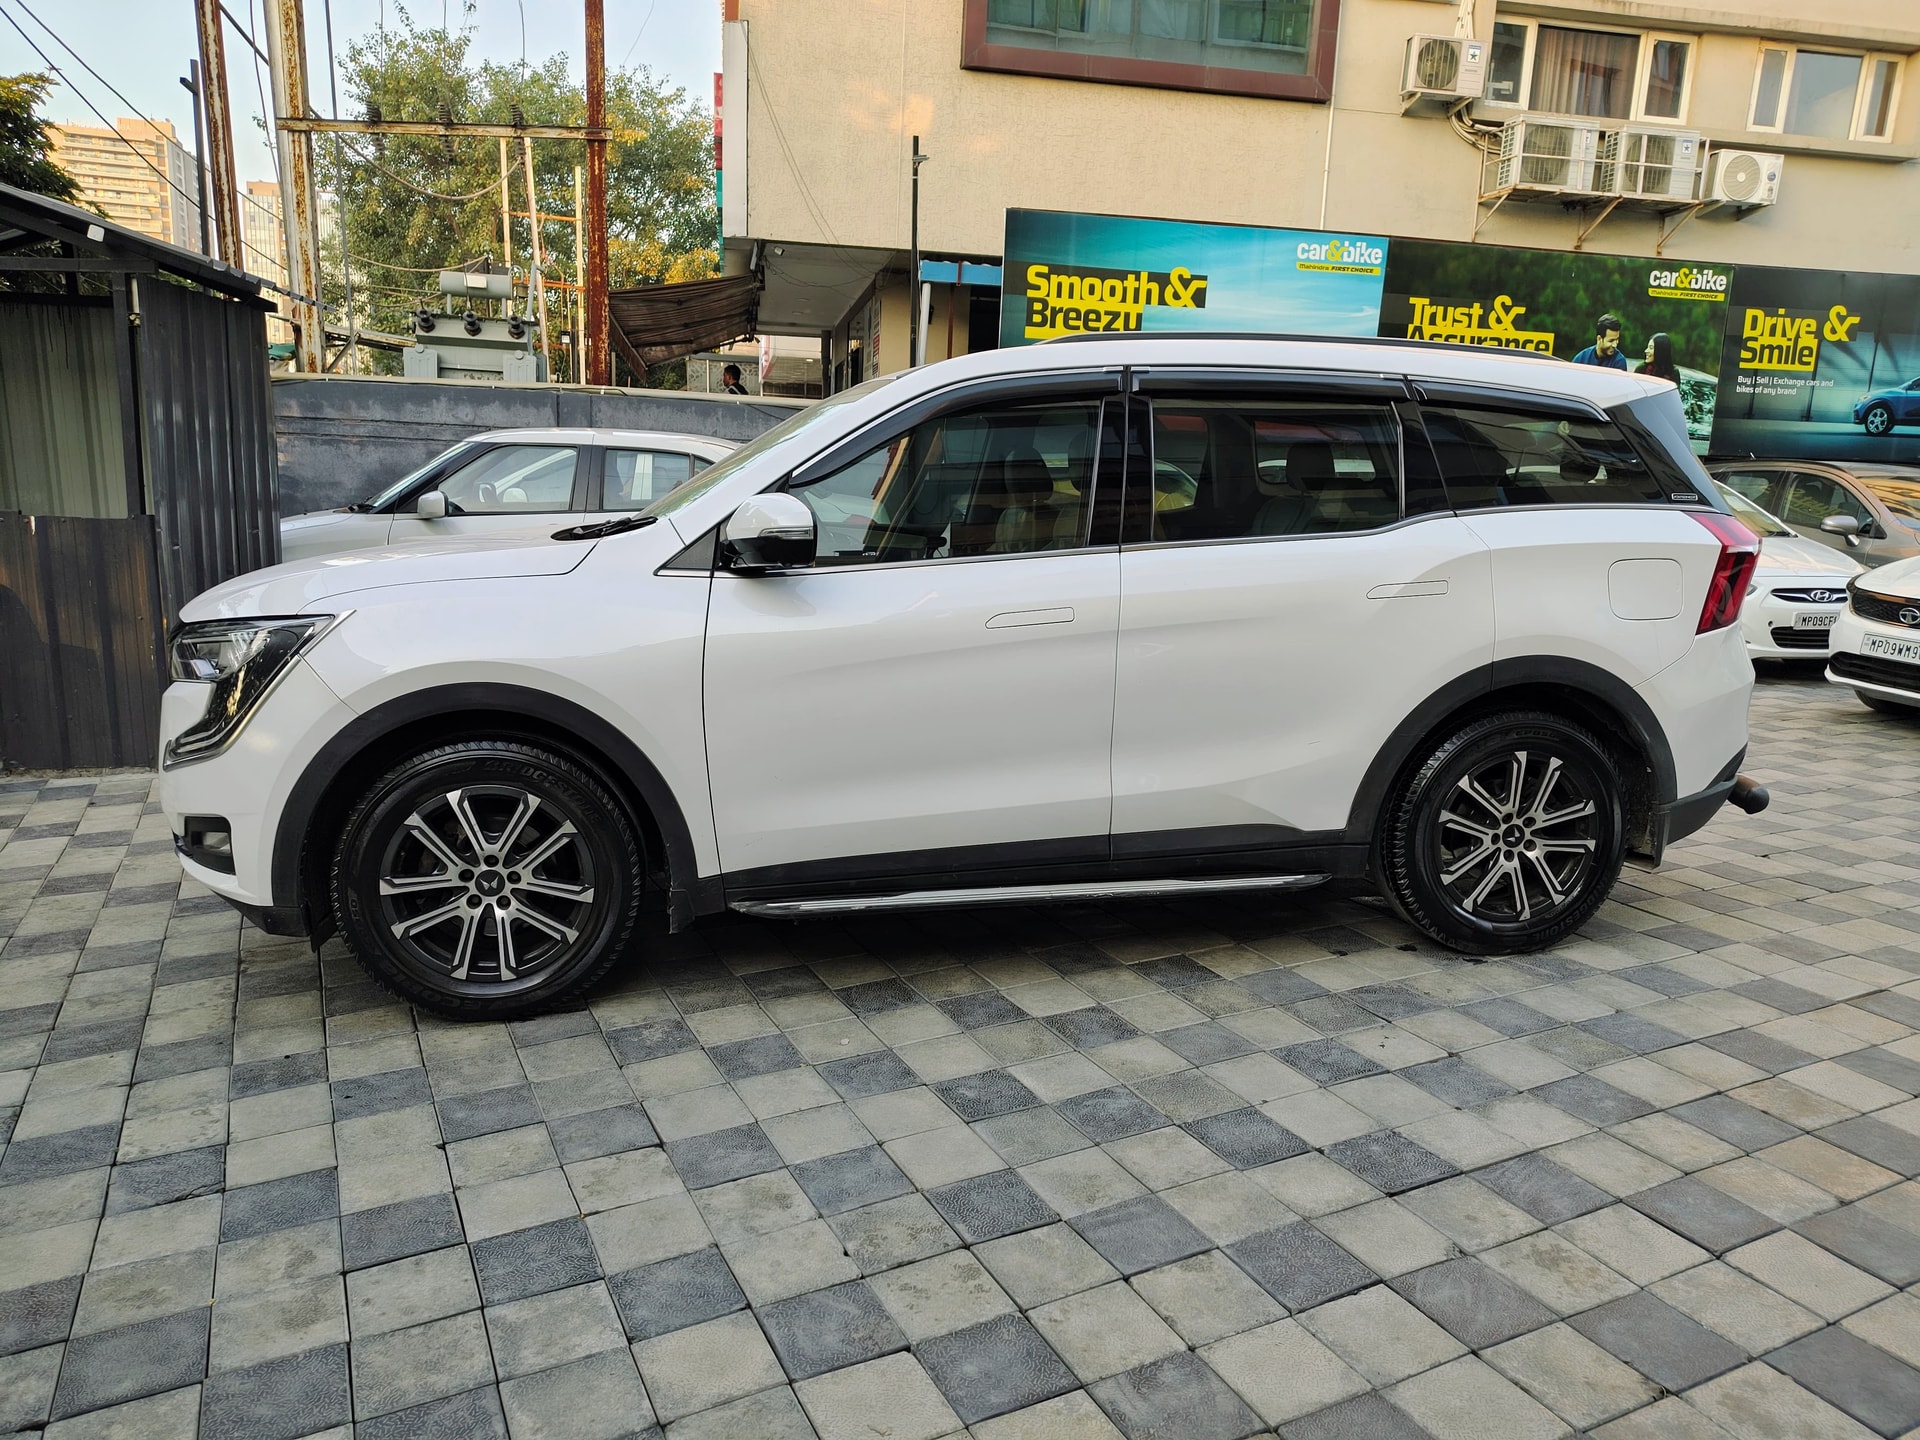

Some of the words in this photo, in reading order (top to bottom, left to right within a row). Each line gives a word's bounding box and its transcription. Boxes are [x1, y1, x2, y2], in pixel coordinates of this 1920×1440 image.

[1297, 240, 1382, 264] car&bike
[1027, 264, 1159, 305] Smooth
[1164, 266, 1208, 308] &
[1649, 267, 1727, 291] car&bike
[1409, 297, 1484, 328] Trust
[1488, 294, 1526, 331] &
[1743, 308, 1817, 339] Drive
[1823, 304, 1861, 341] &
[1740, 336, 1814, 366] Smile
[1736, 385, 1754, 393] bikes
[1777, 387, 1797, 395] brand
[1737, 375, 1751, 384] Buy
[1756, 376, 1769, 384] Sell
[1773, 377, 1804, 387] Exchange
[1820, 379, 1834, 387] and
[1869, 639, 1920, 659] MP09WM9
